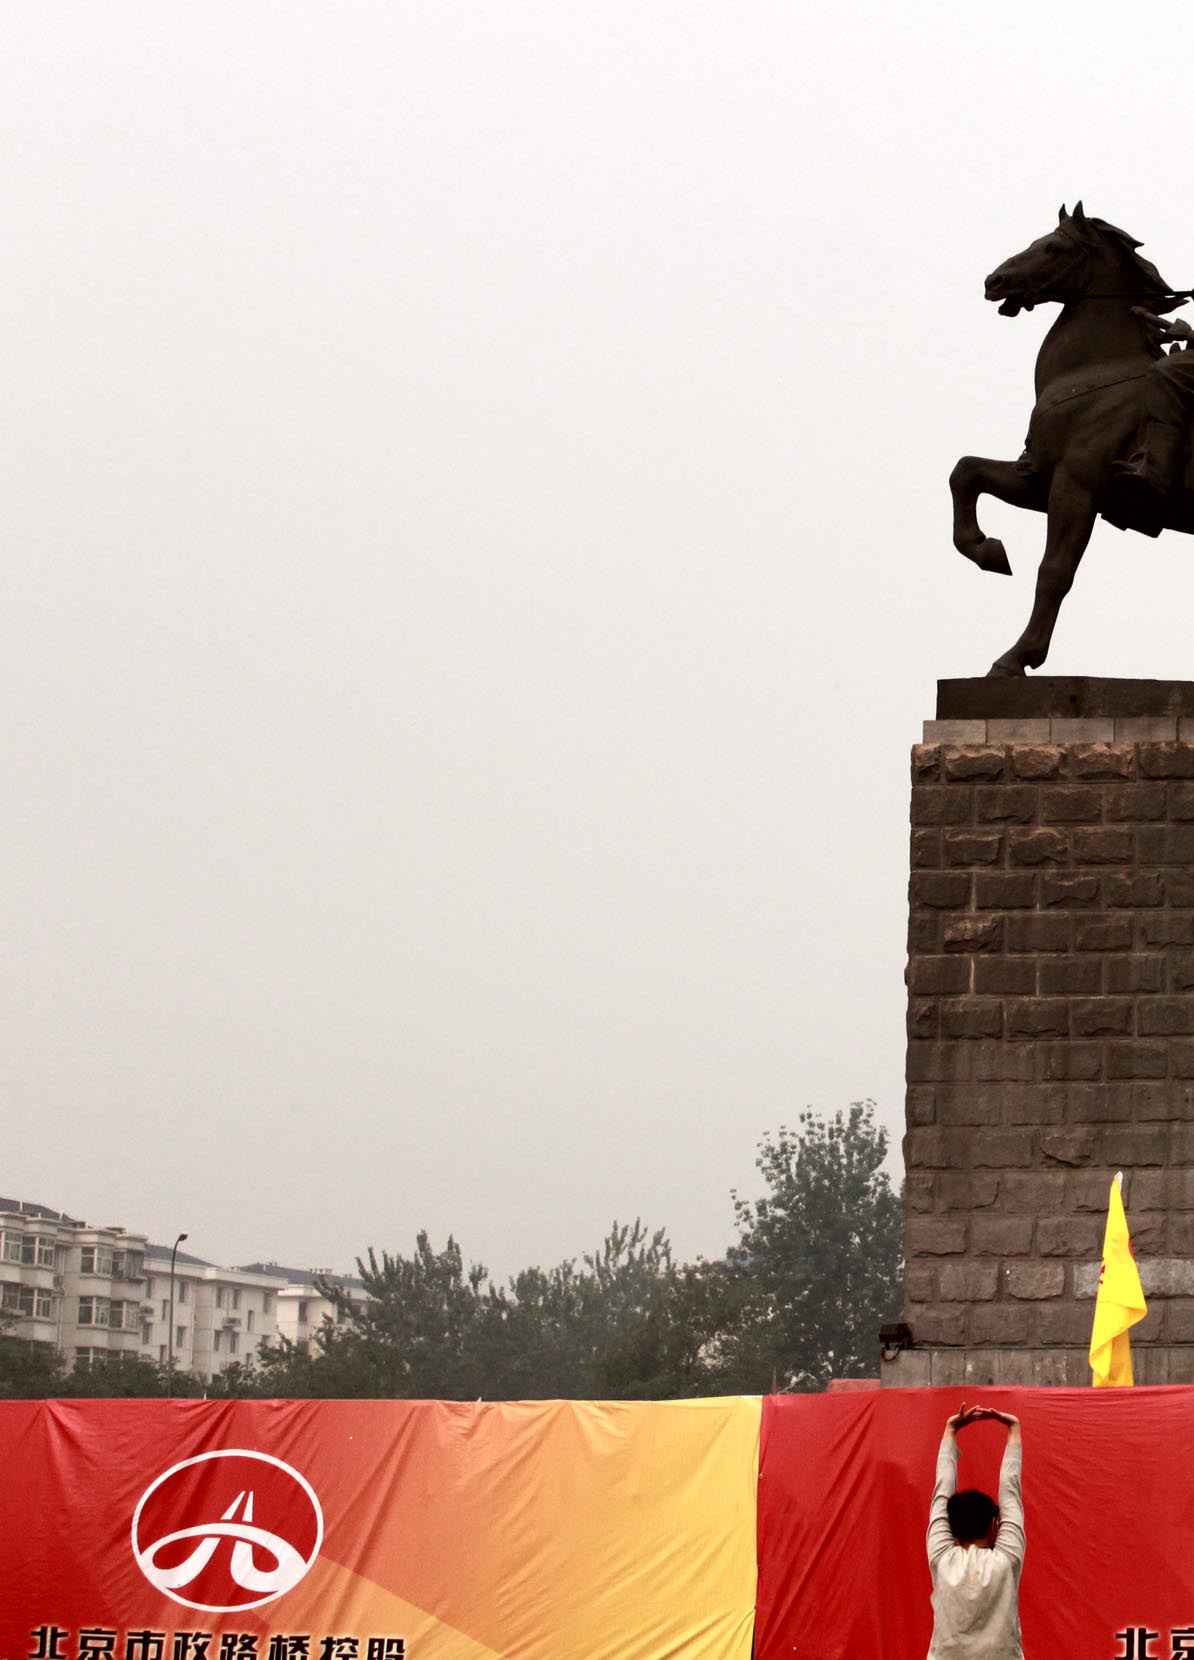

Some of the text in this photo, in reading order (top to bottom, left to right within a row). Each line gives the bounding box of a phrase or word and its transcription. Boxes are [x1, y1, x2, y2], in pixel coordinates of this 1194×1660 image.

[28, 1625, 407, 1660] 北京市政路桥控股
